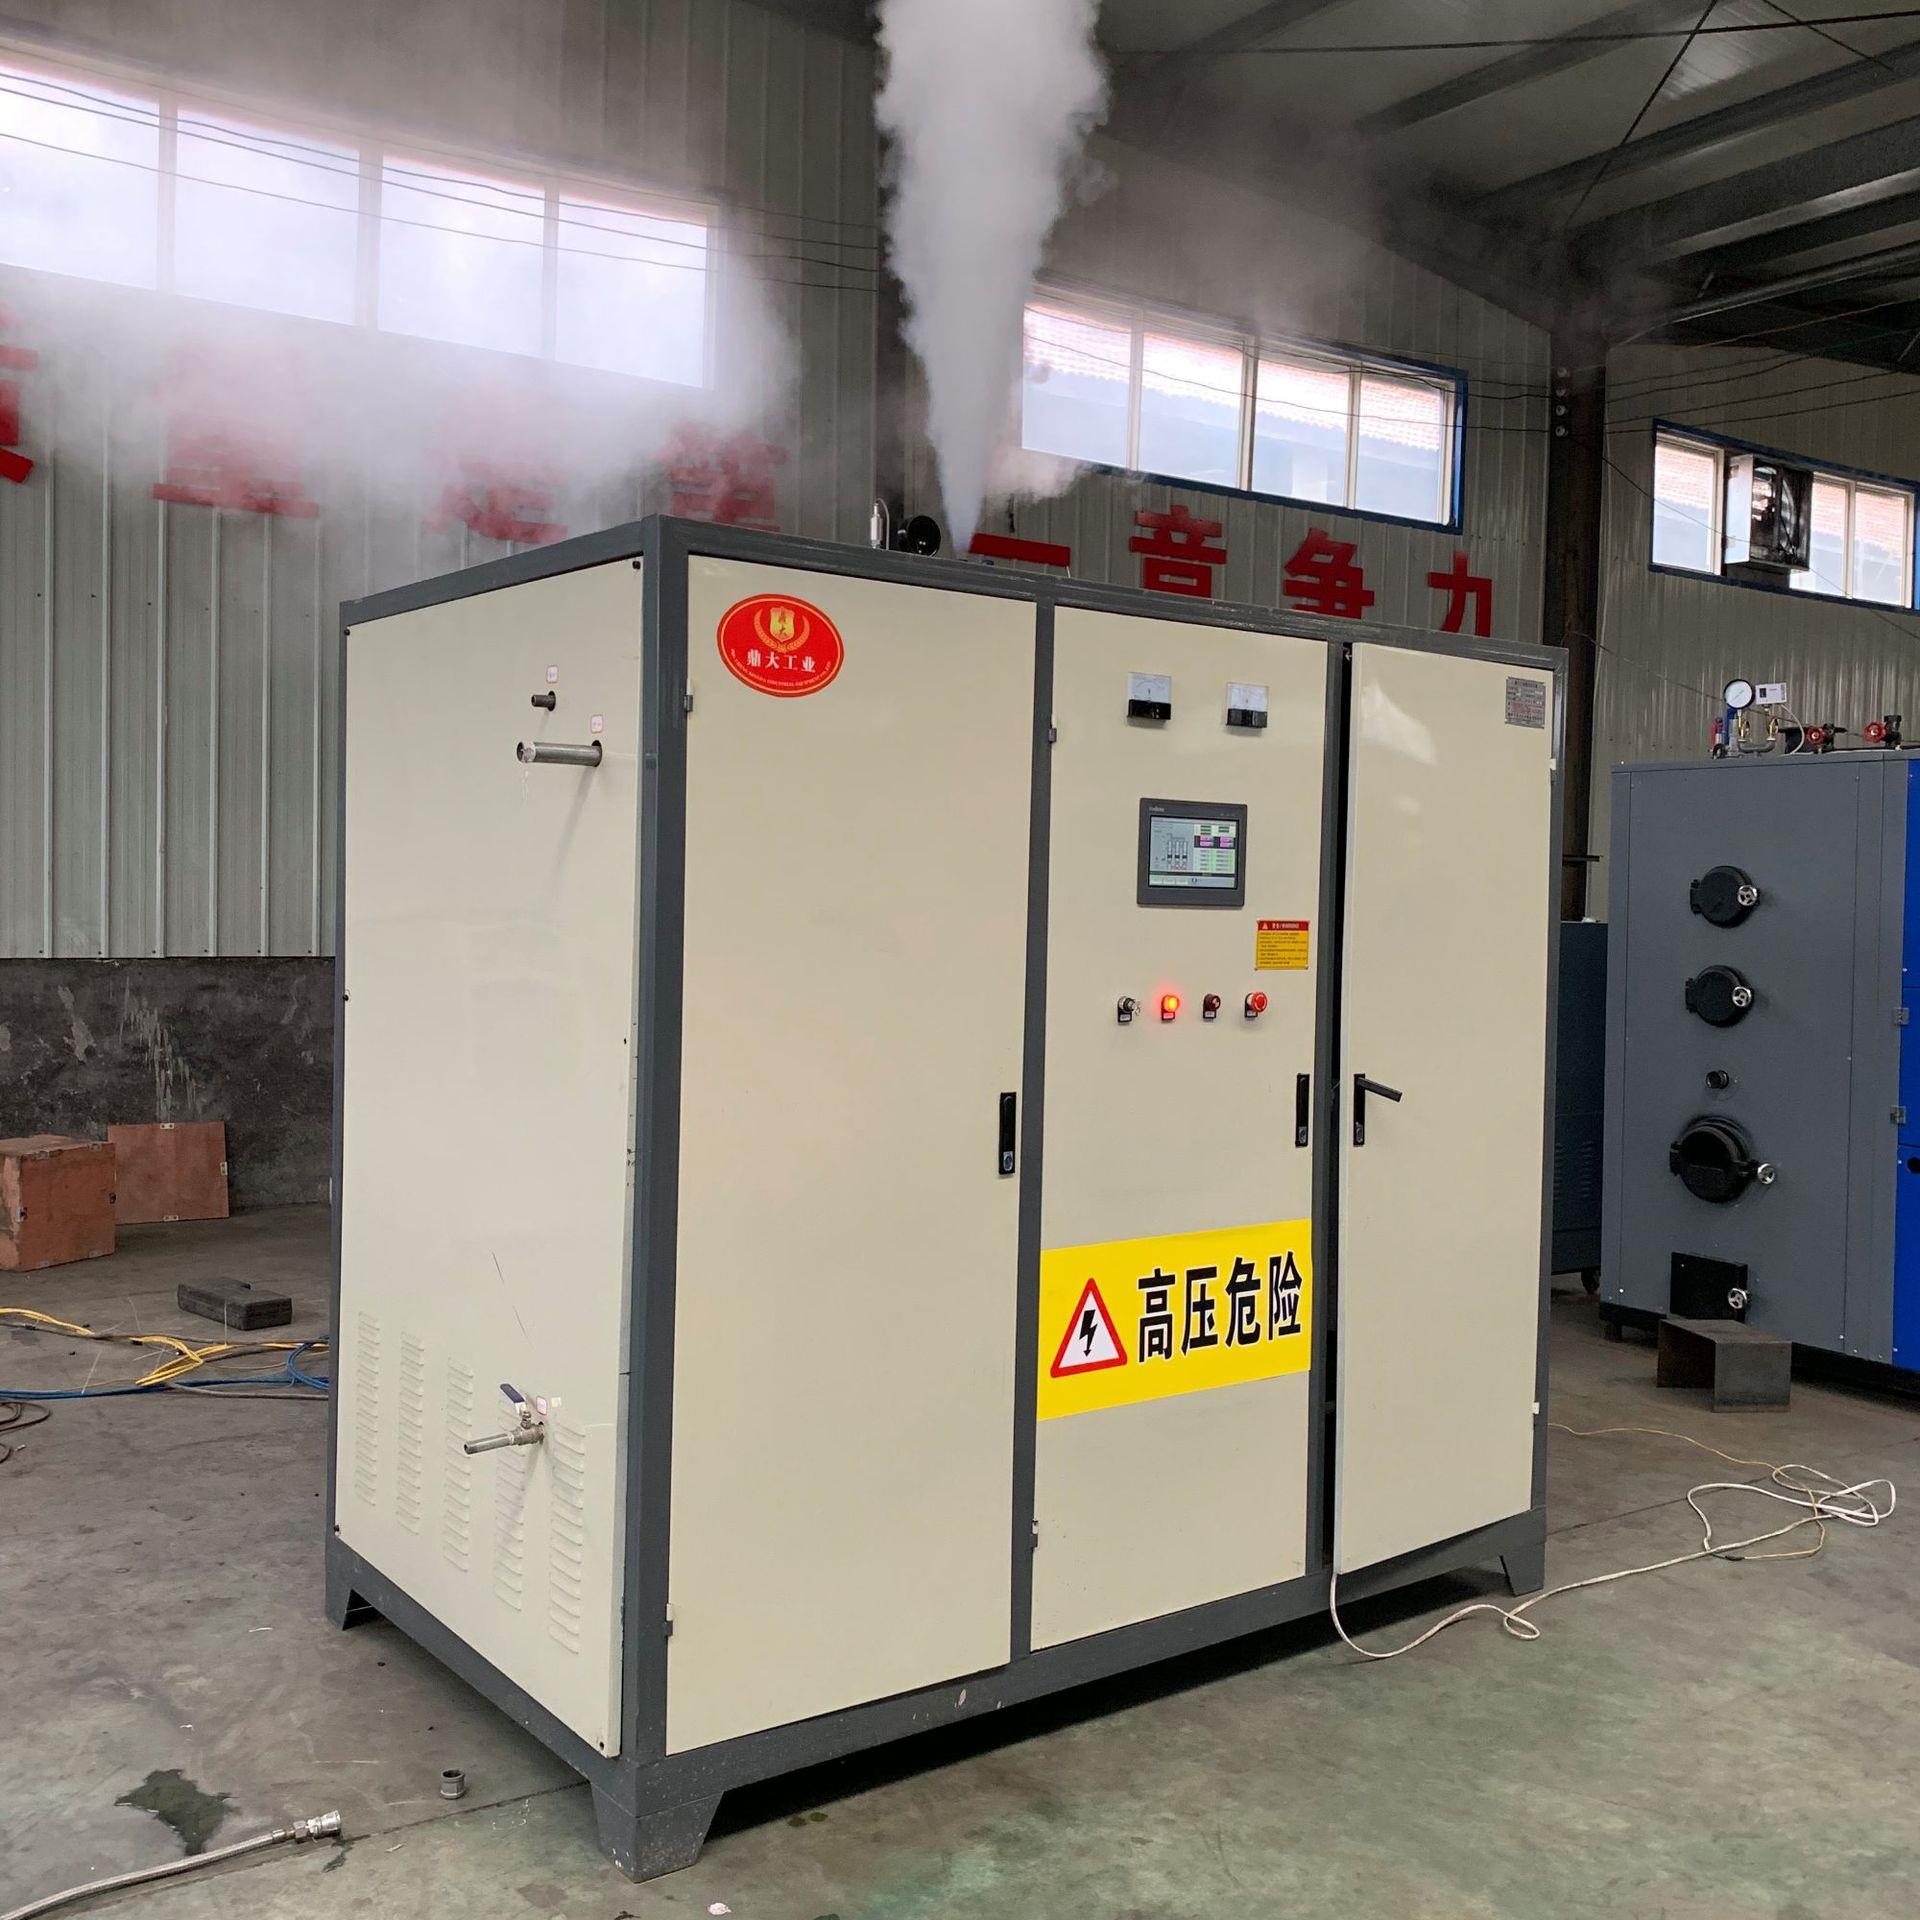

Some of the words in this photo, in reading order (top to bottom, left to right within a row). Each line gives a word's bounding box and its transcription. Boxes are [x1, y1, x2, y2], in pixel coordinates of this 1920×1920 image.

[746, 648, 817, 674] 鼎大工业
[1136, 1250, 1303, 1364] 高压危险
